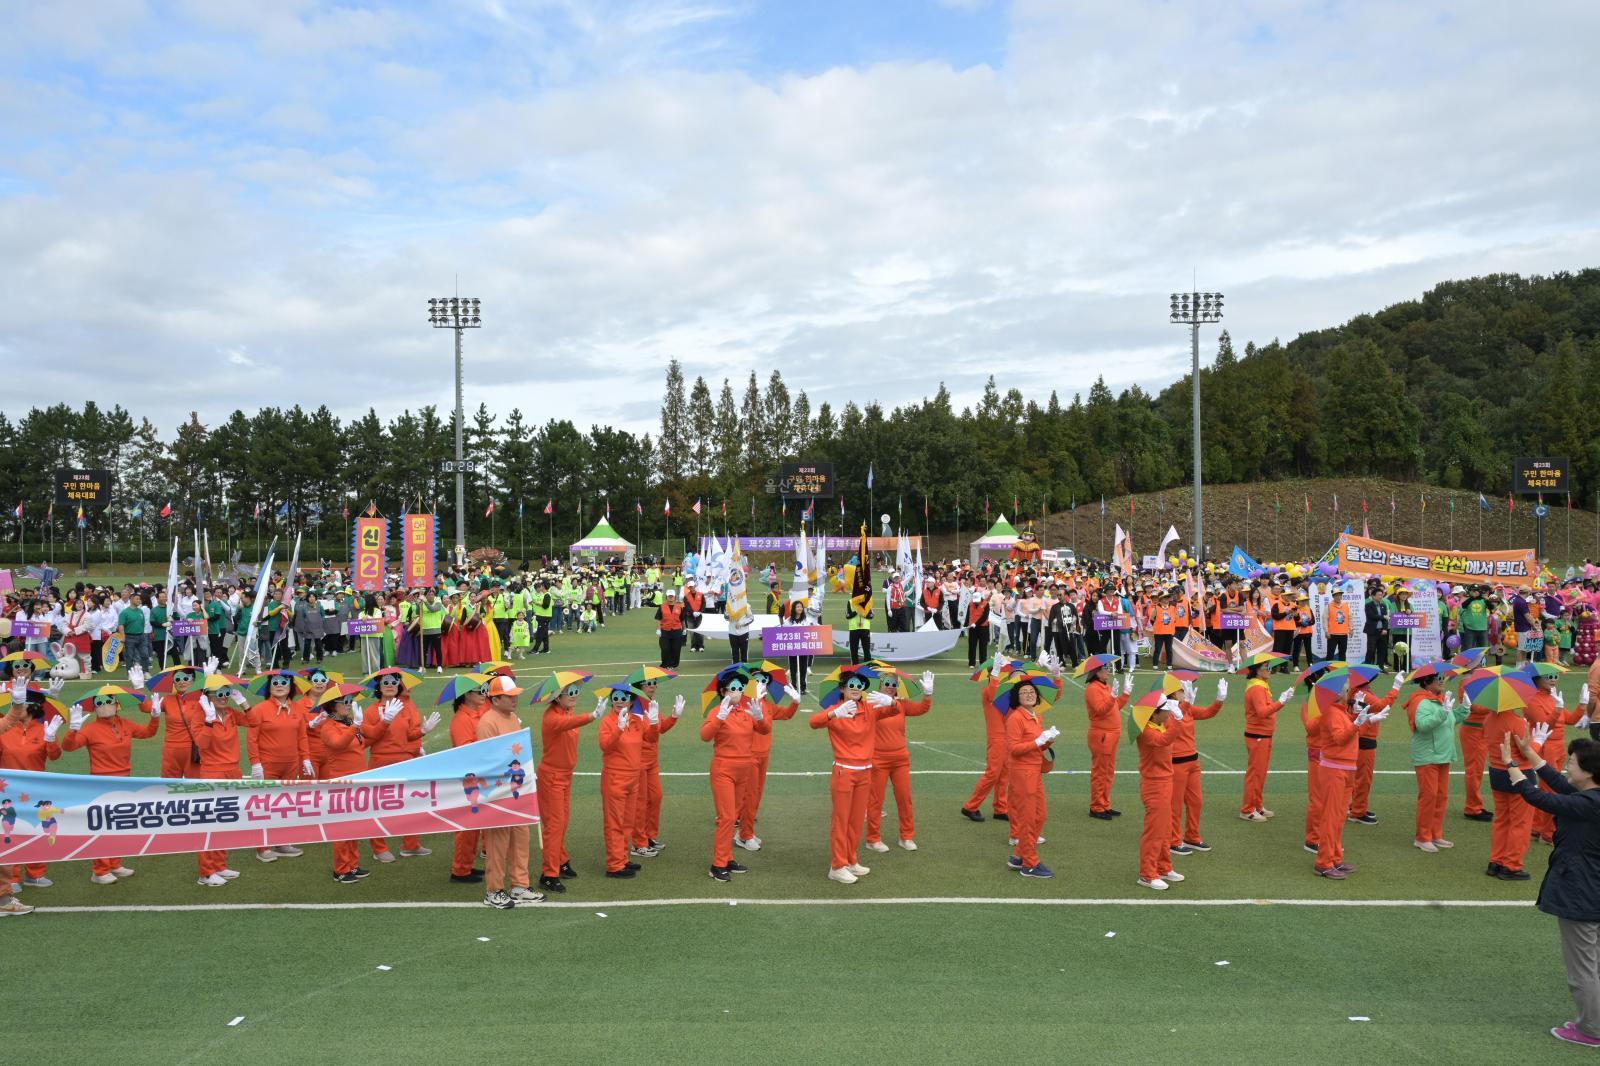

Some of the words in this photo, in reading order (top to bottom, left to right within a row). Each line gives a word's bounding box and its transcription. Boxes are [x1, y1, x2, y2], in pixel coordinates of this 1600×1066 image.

[459, 461, 474, 472] 28
[63, 482, 77, 490] 구민
[80, 482, 100, 490] 한마음
[68, 491, 96, 499] 체육대회
[749, 539, 781, 548] 제23회
[1346, 545, 1387, 565] 울산의
[1431, 555, 1494, 575] 삼산에서
[775, 632, 801, 641] 제23회
[803, 631, 818, 640] 구민
[771, 641, 823, 651] 한마음체육대회
[86, 795, 240, 832] 야음장생포동
[244, 790, 323, 822] 선수단
[327, 783, 405, 816] 파이팅
